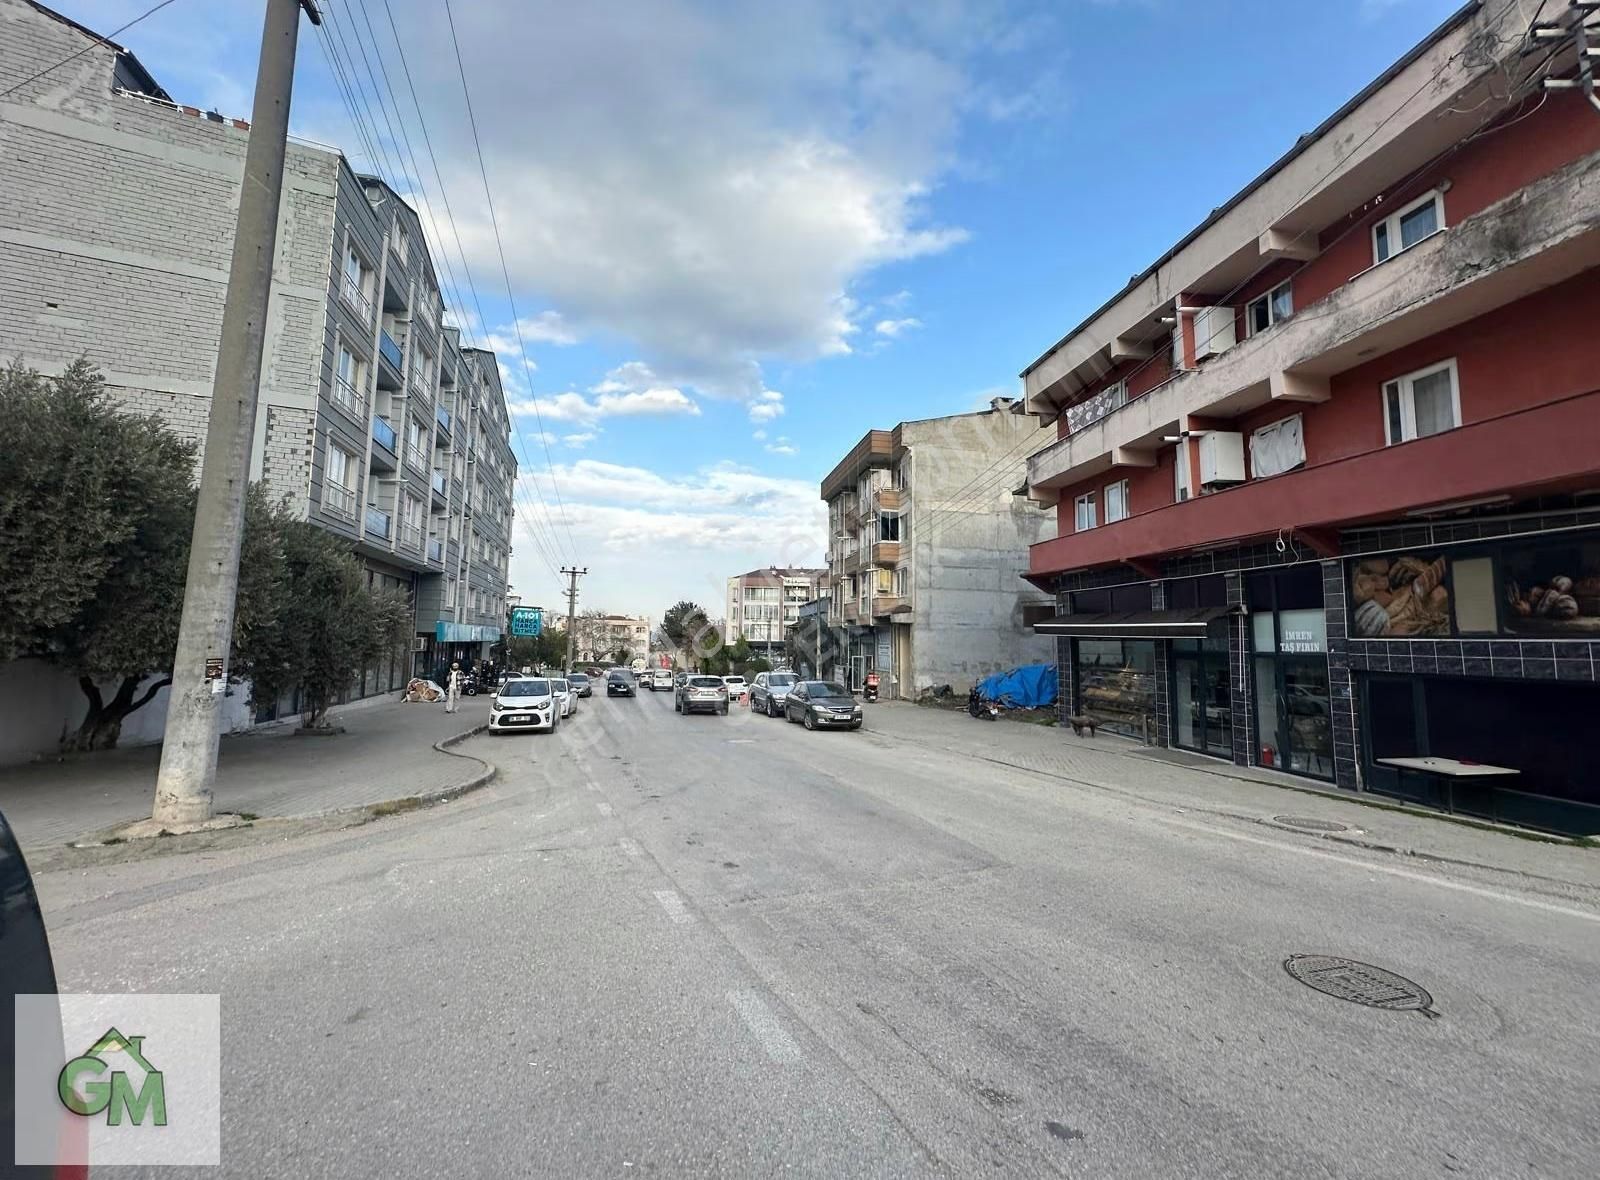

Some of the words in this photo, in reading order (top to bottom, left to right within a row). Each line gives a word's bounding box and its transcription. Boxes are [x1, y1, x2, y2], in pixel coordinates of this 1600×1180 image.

[1285, 628, 1312, 640] İMREN
[1280, 642, 1295, 654] TAŞ
[1296, 642, 1320, 652] FIRIN
